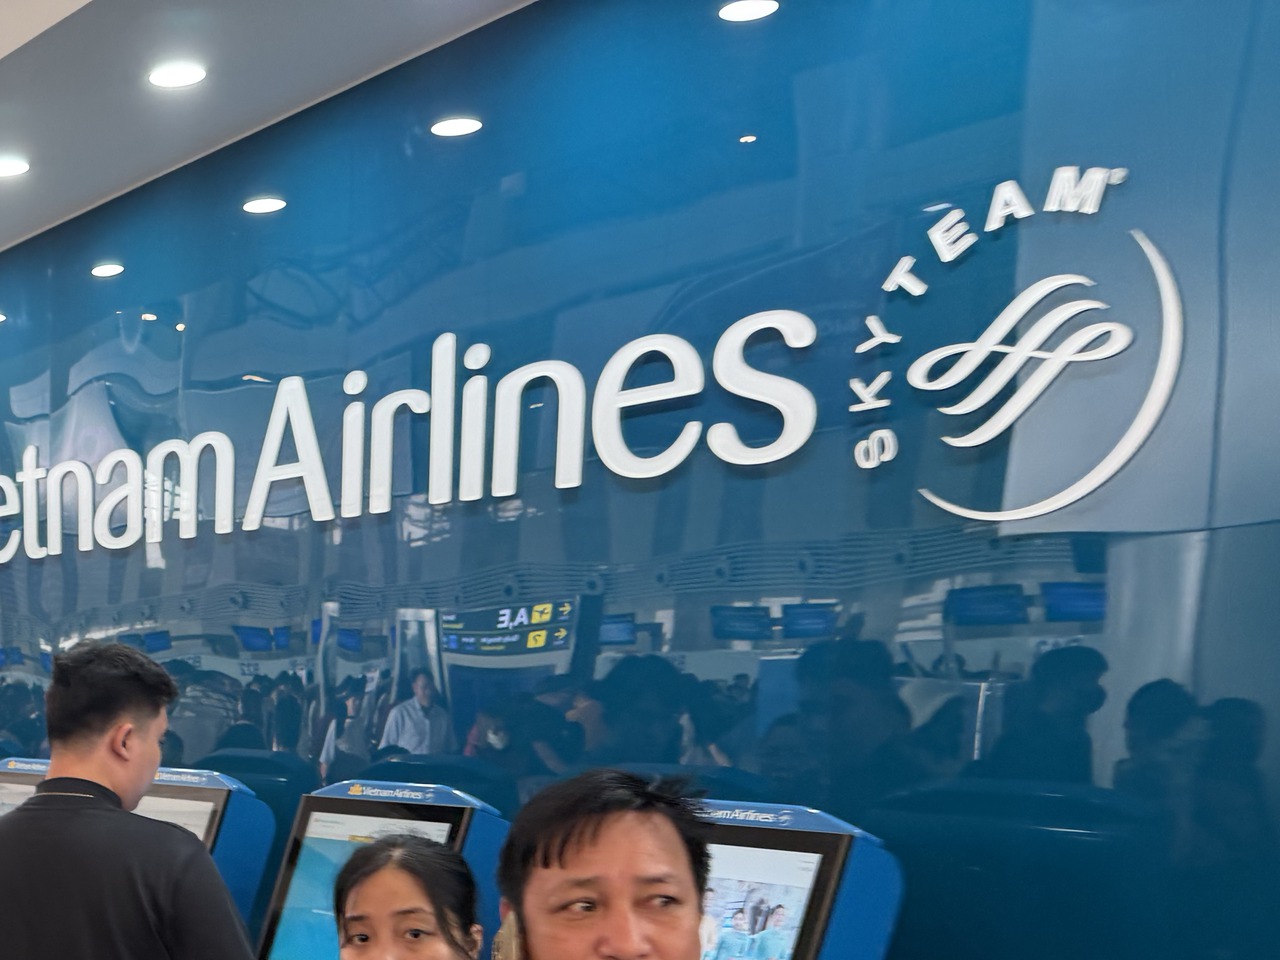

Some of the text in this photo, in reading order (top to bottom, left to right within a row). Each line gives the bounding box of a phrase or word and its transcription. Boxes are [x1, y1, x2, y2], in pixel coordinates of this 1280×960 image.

[848, 165, 1120, 469] SKYTEAM
[241, 309, 818, 531] Airlines
[363, 785, 423, 799] Vietnam Airlines
[731, 809, 776, 823] Airlines
